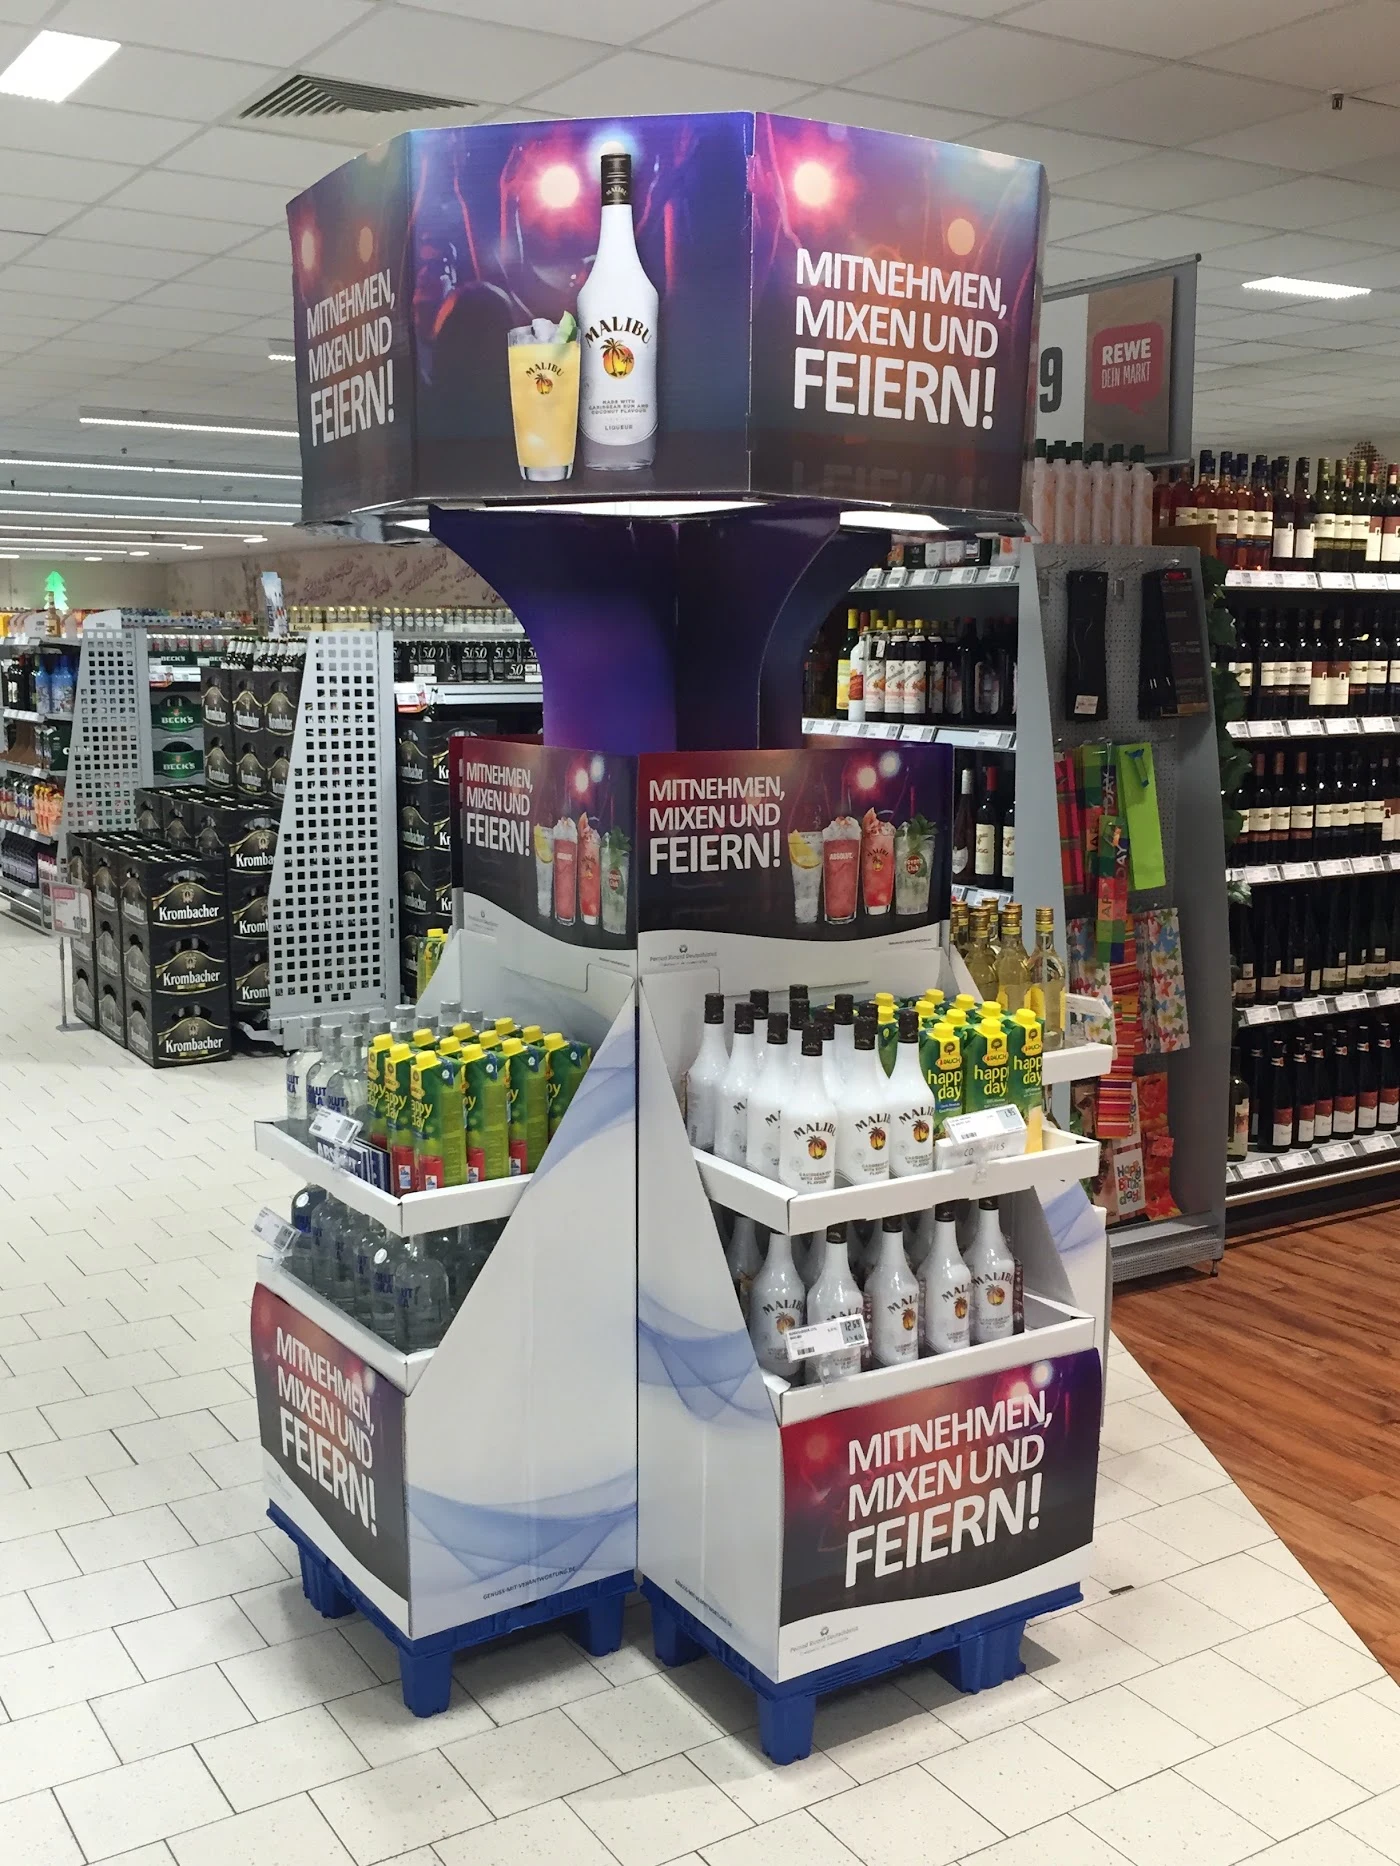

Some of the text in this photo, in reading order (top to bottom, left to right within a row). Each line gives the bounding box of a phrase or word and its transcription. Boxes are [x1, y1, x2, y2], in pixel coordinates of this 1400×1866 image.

[796, 248, 1007, 319] MITNEHMEN,
[306, 268, 396, 340] MITNEHMEN,
[584, 316, 652, 349] MALIBU
[795, 296, 998, 359] MIXEN UND
[308, 316, 394, 384] MIXEN UND
[1101, 338, 1151, 366] REWE
[525, 362, 565, 378] MALIBU
[1039, 346, 1064, 413] 9
[1101, 361, 1151, 390] DEIN MARKT
[310, 360, 396, 447] FEIERN!
[793, 347, 996, 430] FEIERN!
[161, 715, 194, 724] BECK'S
[163, 762, 195, 770] BECK'S
[466, 761, 534, 792] MITNEHMEN,
[466, 786, 530, 816] MIXEN UND
[648, 775, 785, 803] MITNEHMEN,
[649, 802, 781, 832] MIXEN UND
[465, 812, 531, 857] FEIERN!
[649, 830, 781, 875] FEIERN!
[159, 905, 219, 921] Krombacher
[163, 971, 221, 987] Krombacher
[165, 1037, 224, 1053] Krombacher
[938, 1084, 962, 1101] day
[984, 1081, 1008, 1096] day
[1117, 1160, 1142, 1181] Happy
[1119, 1190, 1139, 1206] day
[276, 1326, 375, 1436] MITNEHMEN,
[277, 1364, 373, 1470] MIXEN UND
[849, 1390, 1053, 1475] MITNEHMEN,
[281, 1406, 377, 1537] FEIERN!
[848, 1434, 1045, 1522] MIXEN UND
[845, 1472, 1043, 1588] FEIERN!
